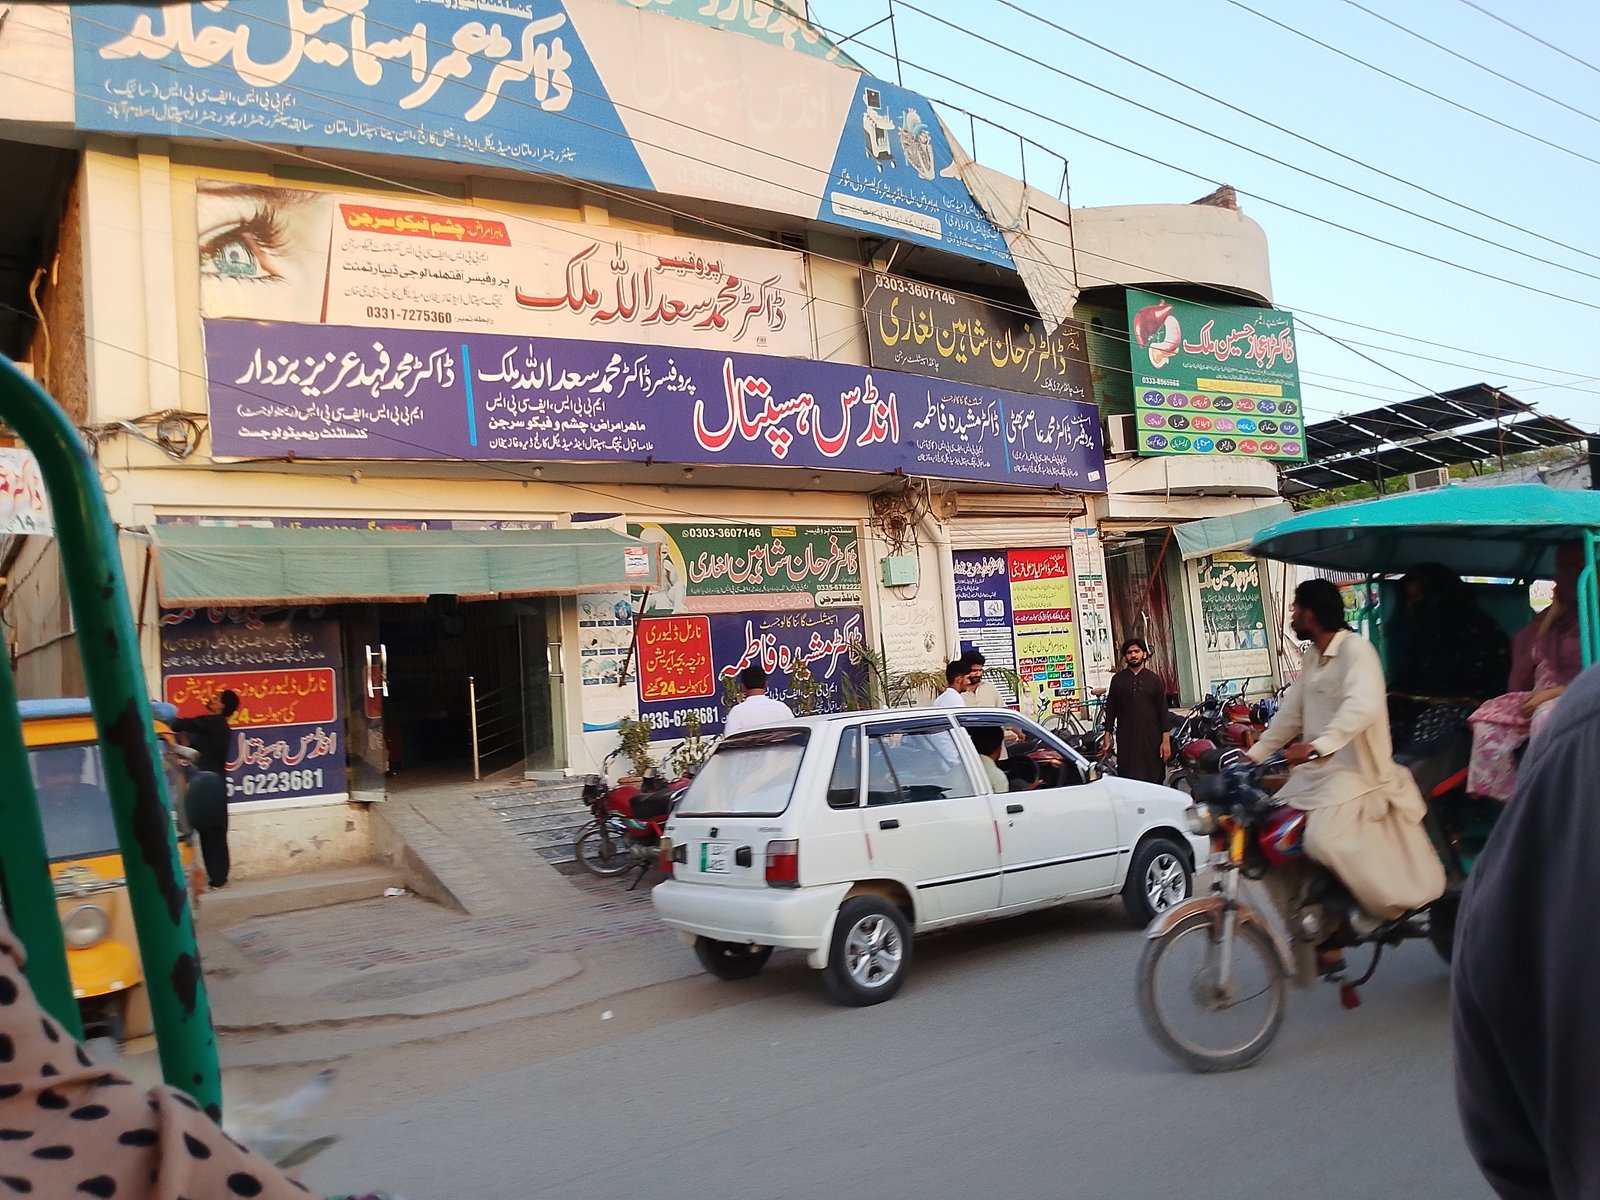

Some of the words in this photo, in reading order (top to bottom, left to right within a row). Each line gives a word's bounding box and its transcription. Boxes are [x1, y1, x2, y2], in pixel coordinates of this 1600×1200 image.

[464, 13, 574, 122] ڈاکٹر
[280, 92, 296, 111] ایم
[348, 211, 396, 229] سرجن
[395, 214, 431, 233] فیکو
[430, 219, 466, 241] چشم
[465, 271, 510, 288] پروفیسر
[514, 241, 602, 313] ملک
[589, 240, 652, 325] اللہ
[655, 251, 723, 284] پروفیسر
[692, 275, 743, 332] محمد
[874, 274, 957, 305] 0303-3607146
[366, 305, 452, 324] 0331-7275360
[640, 294, 715, 327] سعد
[733, 274, 787, 341] ڈاکٹر
[879, 296, 935, 347] لغاری
[936, 317, 989, 364] شاہین
[990, 323, 1038, 373] فرحان
[1183, 320, 1216, 355] ملک
[1214, 323, 1256, 361] حسین
[1245, 334, 1271, 368] اعجاز
[1266, 327, 1295, 369] ڈاکٹر
[235, 347, 302, 387] بزدار
[299, 350, 361, 398] عزیز
[345, 341, 391, 399] فہد
[381, 352, 415, 391] محمد
[404, 346, 456, 399] ڈاکٹر
[477, 345, 520, 383] ملک
[511, 343, 552, 391] اللہ
[588, 352, 623, 394] محمد
[1033, 332, 1067, 383] ڈاکٹر
[549, 367, 600, 392] سعد
[617, 353, 651, 399] ڈاکٹر
[646, 358, 697, 397] پروفیسر
[320, 403, 332, 425] پی
[331, 405, 344, 422] سی
[343, 407, 366, 423] ایف
[409, 405, 424, 424] ایم
[485, 391, 507, 412] ایس
[506, 394, 517, 416] پی
[518, 397, 530, 413] سی
[528, 398, 551, 413] ایف
[573, 396, 584, 417] بی
[583, 396, 594, 417] بی
[593, 397, 606, 416] ایم
[693, 357, 815, 460] ہسپتال
[812, 374, 899, 457] انڈس
[913, 390, 951, 432] فاطمہ
[320, 426, 369, 440] کنسلٹنٹ
[488, 416, 525, 431] سرجن
[527, 416, 553, 431] فیکو
[552, 419, 561, 431] و
[561, 416, 589, 433] چشم
[978, 400, 1000, 443] ڈاکٹر
[1006, 409, 1025, 443] بھٹی
[1055, 414, 1072, 451] ڈاکٹر
[534, 432, 549, 450] کالج
[689, 528, 761, 539] 0303-3607146
[688, 551, 732, 584] لغاری
[728, 538, 790, 585] شاہین
[786, 534, 839, 584] فرحان
[829, 540, 859, 584] ڈاکٹر
[819, 594, 840, 605] سرجن
[645, 621, 680, 645] ڈلیوری
[824, 614, 863, 679] ڈاکٹر
[646, 647, 677, 673] آپریشن
[718, 620, 777, 685] فاطمہ
[660, 680, 676, 696] 24
[700, 674, 710, 694] کی
[225, 732, 286, 772] ہسپتال
[283, 727, 337, 767] انڈس
